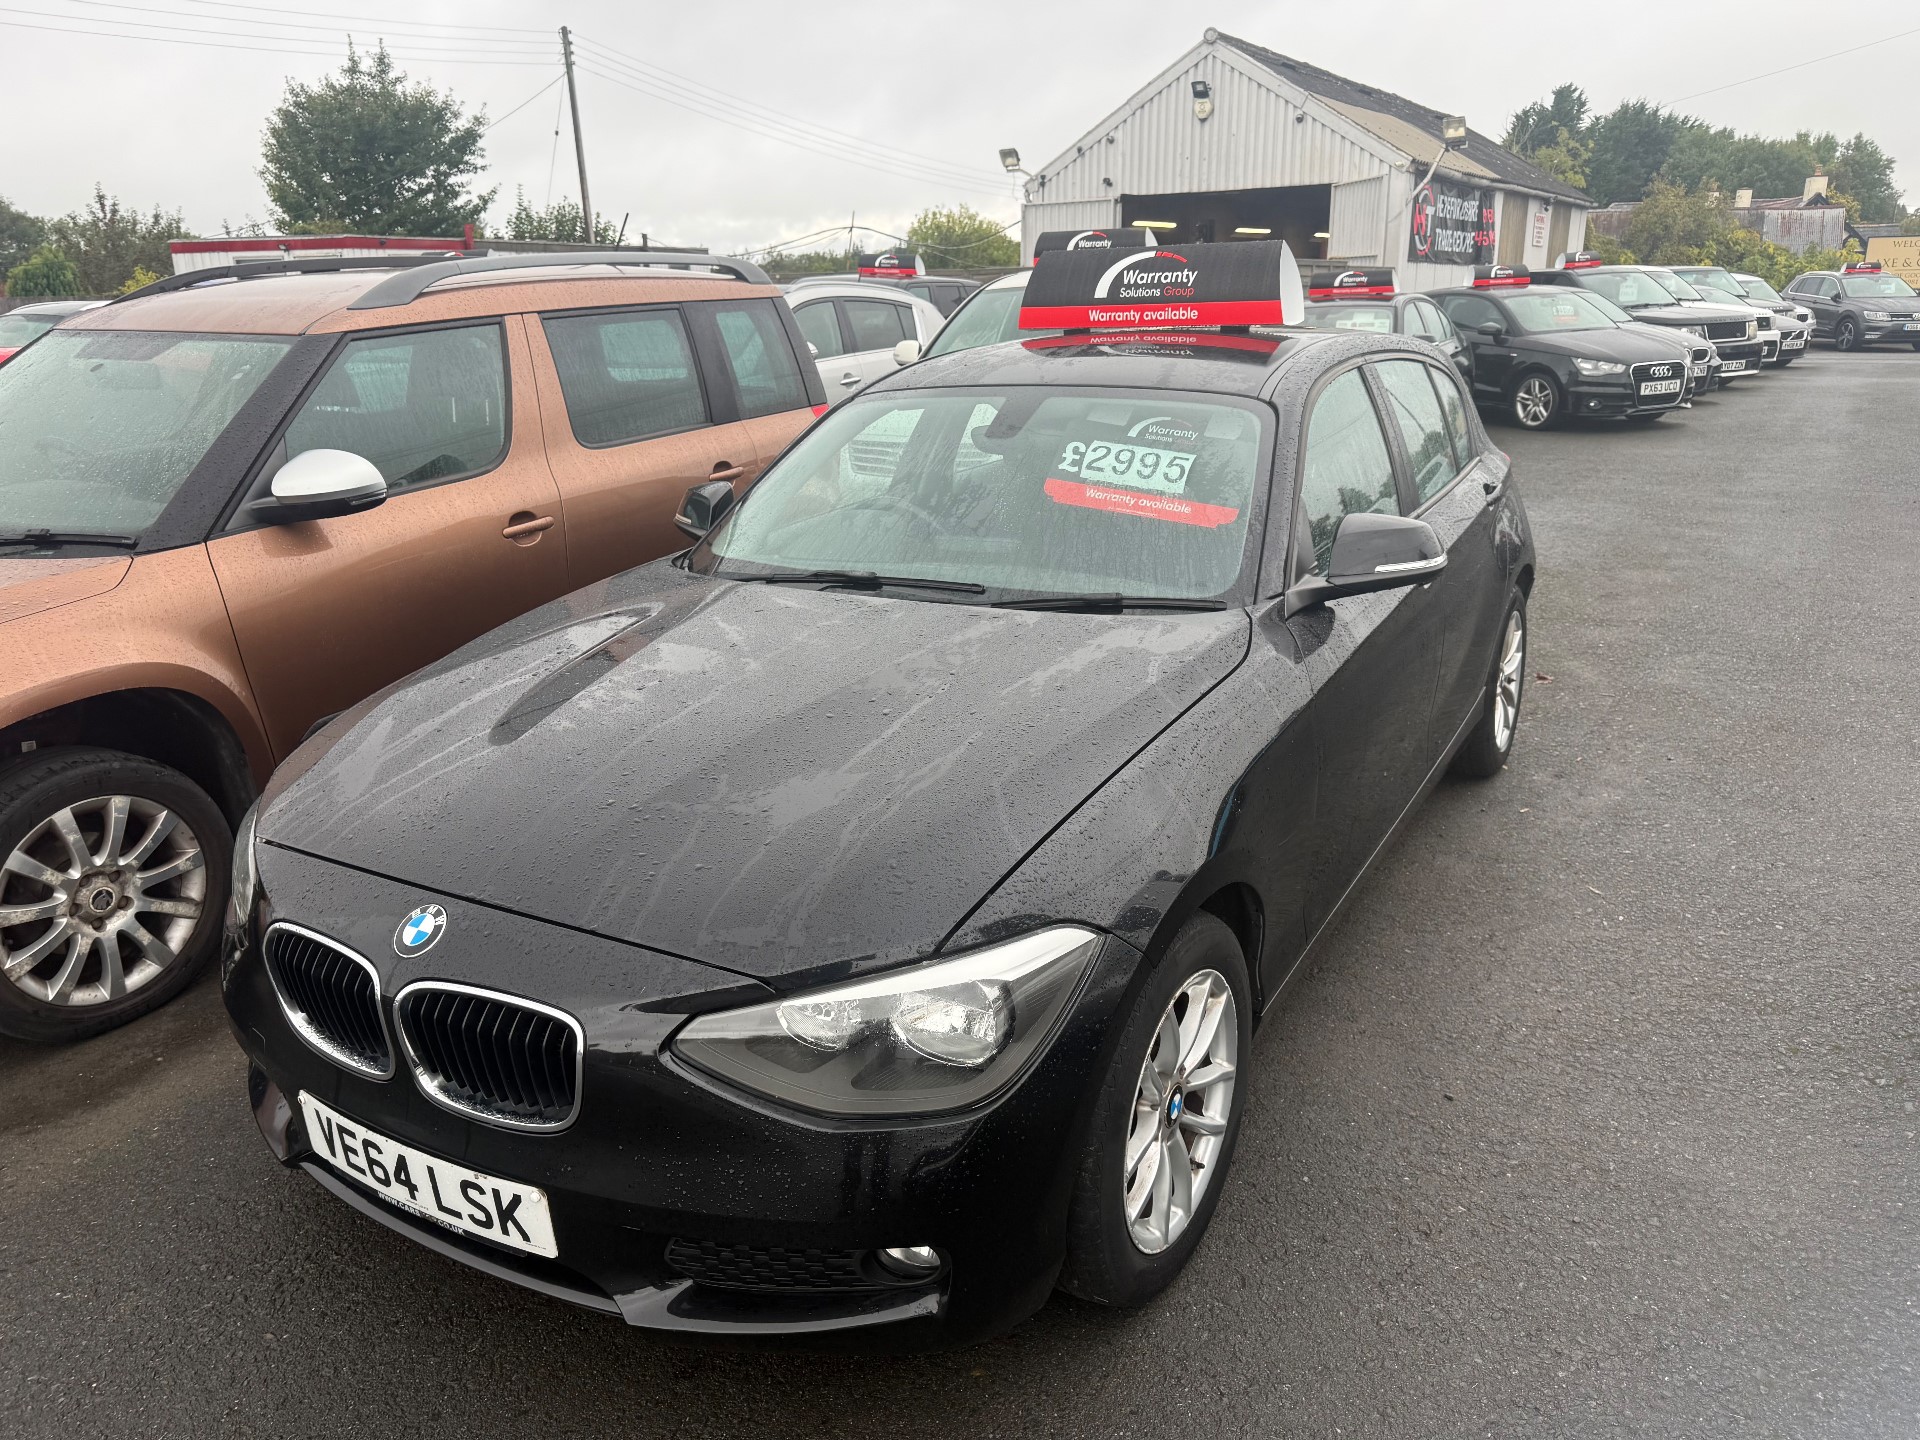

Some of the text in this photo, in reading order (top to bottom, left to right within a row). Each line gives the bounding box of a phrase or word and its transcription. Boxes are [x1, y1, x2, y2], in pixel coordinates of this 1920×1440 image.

[1078, 240, 1112, 249] Warranty
[1123, 268, 1198, 286] Warranty
[1119, 286, 1195, 298] Solutions Group
[1088, 307, 1198, 323] Warranty available
[1643, 383, 1663, 393] PX63
[1144, 433, 1173, 443] Solutions
[1149, 424, 1199, 440] Warranty
[1058, 441, 1190, 484] £2995
[1085, 486, 1140, 507] Warranty
[1138, 495, 1192, 514] available
[314, 1107, 531, 1243] VE64 LSK
